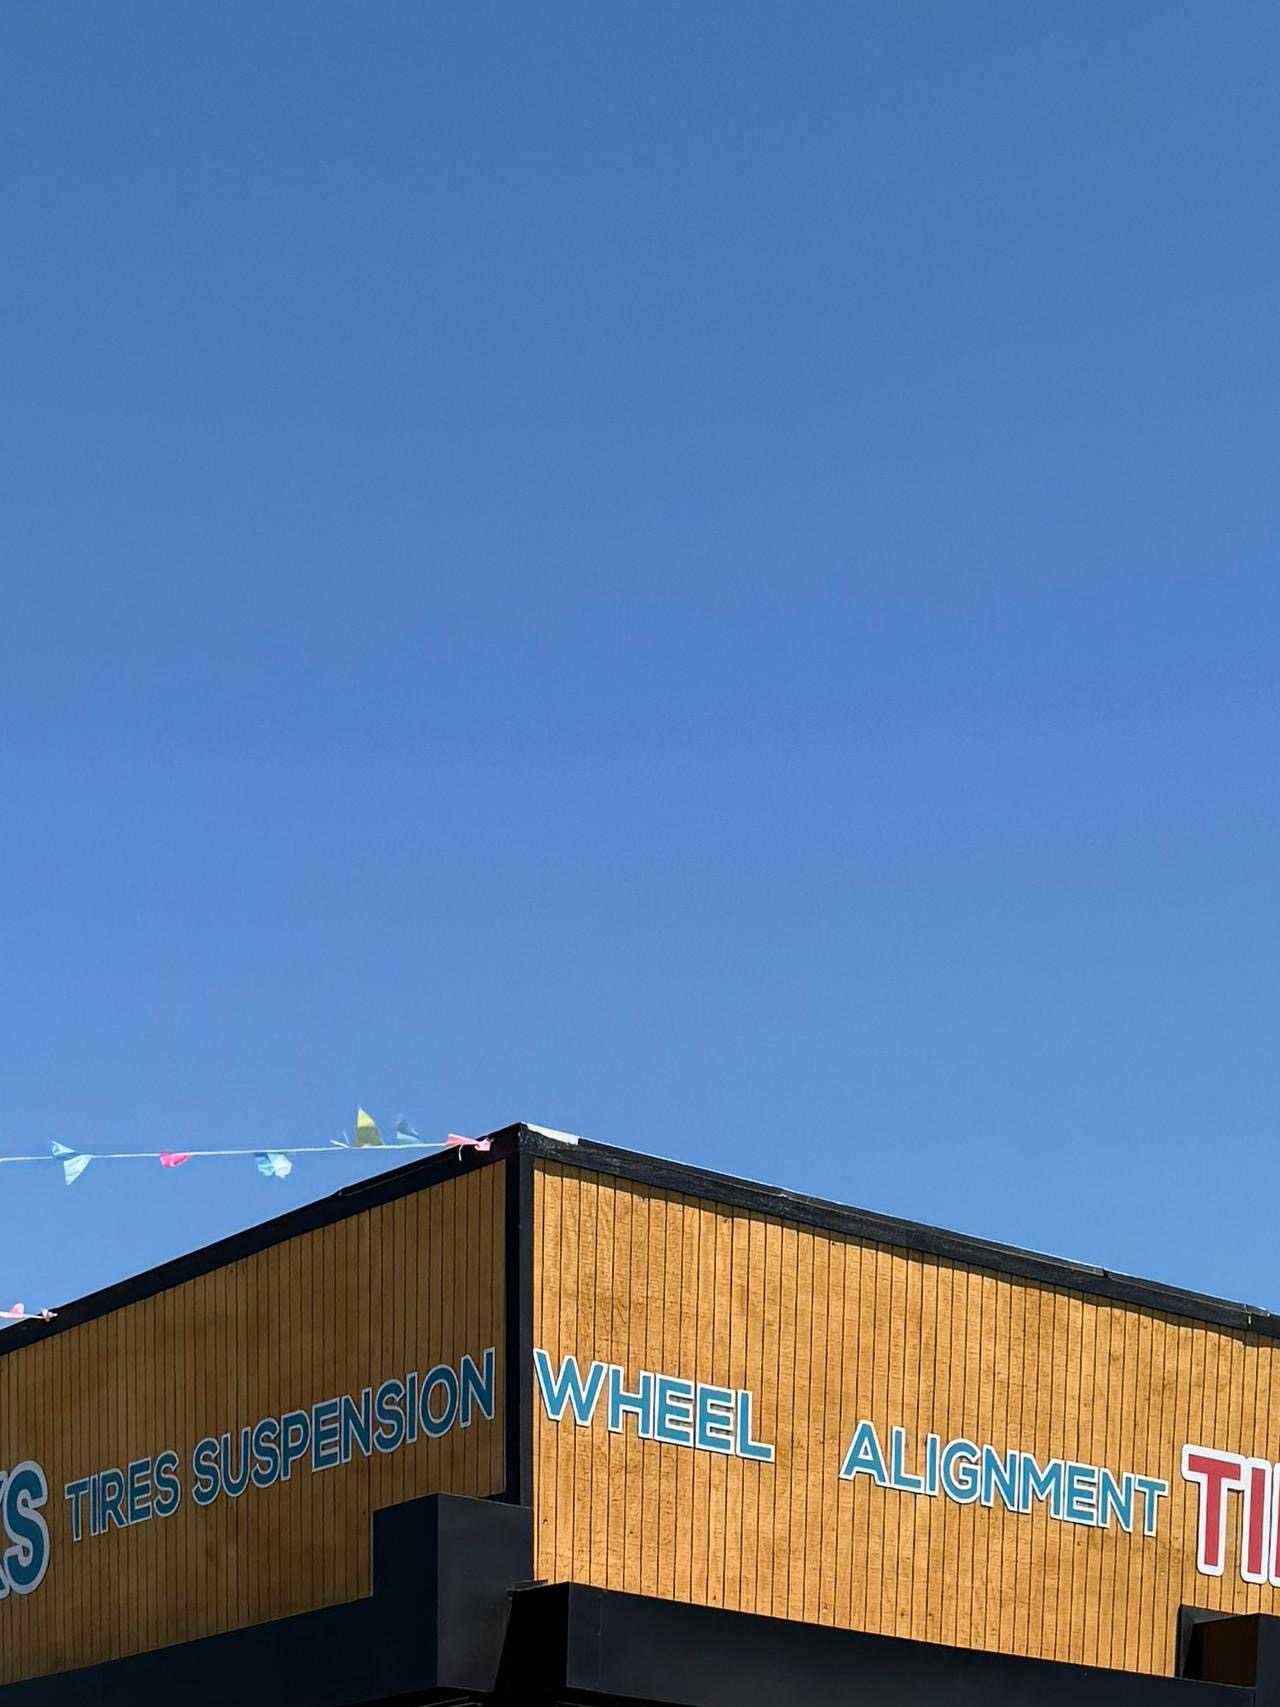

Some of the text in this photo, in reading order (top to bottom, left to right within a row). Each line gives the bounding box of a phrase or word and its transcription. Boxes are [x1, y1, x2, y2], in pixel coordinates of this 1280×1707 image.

[65, 1449, 181, 1542] TIRES
[192, 1346, 496, 1505] SUSPENSION
[533, 1348, 775, 1463] WHEEL
[839, 1419, 1169, 1537] ALIGNMENT
